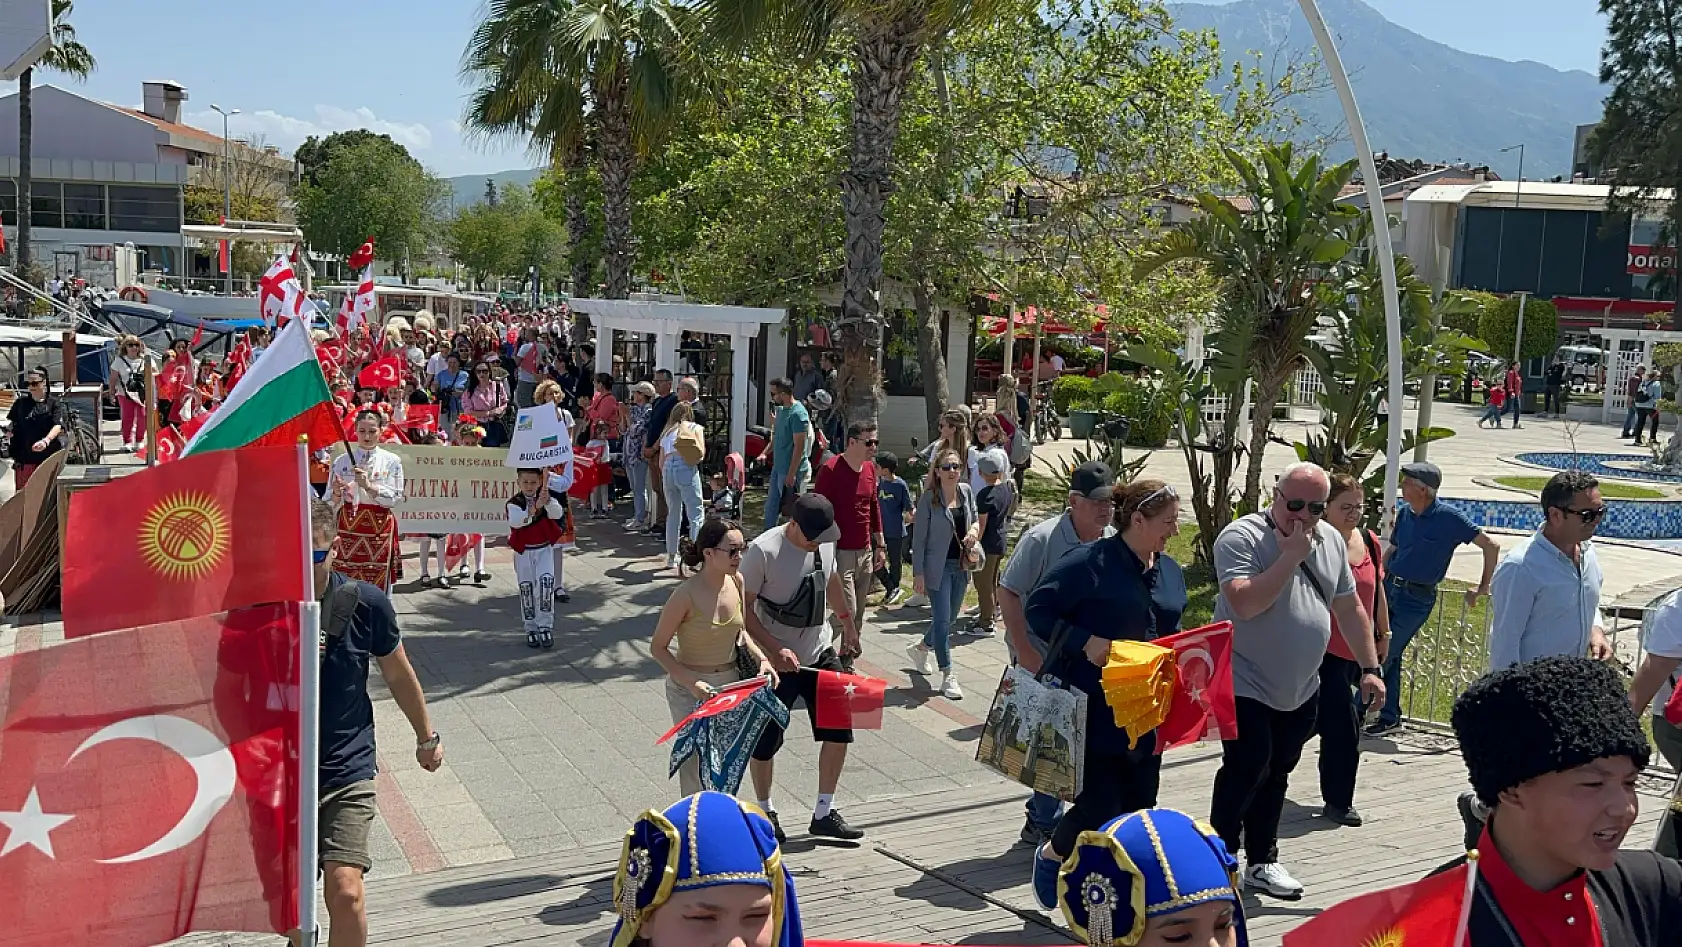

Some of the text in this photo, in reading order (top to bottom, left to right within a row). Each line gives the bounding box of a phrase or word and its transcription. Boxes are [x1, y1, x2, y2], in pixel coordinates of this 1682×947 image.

[519, 445, 569, 461] BULGARISTAN
[416, 456, 505, 467] FOLK ENSEMBL
[471, 480, 516, 499] TRAKI
